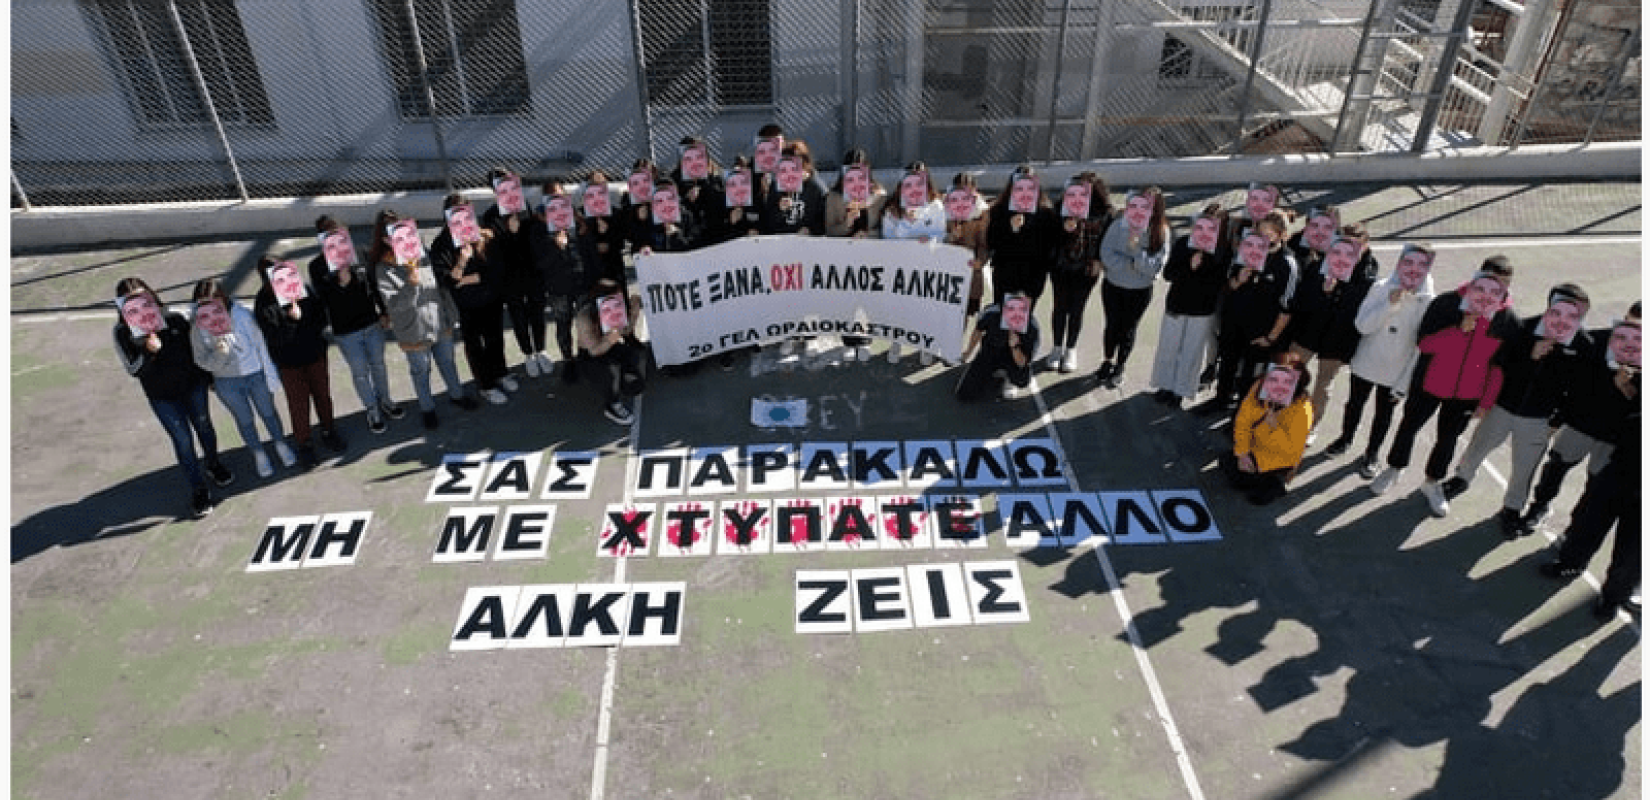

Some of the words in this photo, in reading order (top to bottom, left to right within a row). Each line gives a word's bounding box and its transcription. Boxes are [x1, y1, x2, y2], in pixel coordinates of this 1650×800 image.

[647, 279, 703, 313] ΠΟΤΕ
[770, 262, 803, 291] ΟΧΙ
[811, 263, 884, 291] ΑΛΛΟΣ
[892, 267, 964, 304] ΑΛΚΗΣ
[719, 327, 760, 348] ΓΕΛ
[766, 320, 935, 348] ΩΡΑΙΟΚΑΣΤΡΟΥ
[435, 458, 592, 494] ΣΑΣ
[638, 446, 1063, 489] ΠΑΡΑΚΑΛΩ
[252, 519, 365, 564] ΜΗ
[436, 513, 549, 553] ΜΕ
[602, 498, 980, 549] ΧΤΥΠΑΤΕ
[1007, 496, 1212, 537] ΑΛΛΟ
[454, 591, 682, 640] ΑΛΚΗ
[799, 571, 1021, 622] ΖΕΙΣ
